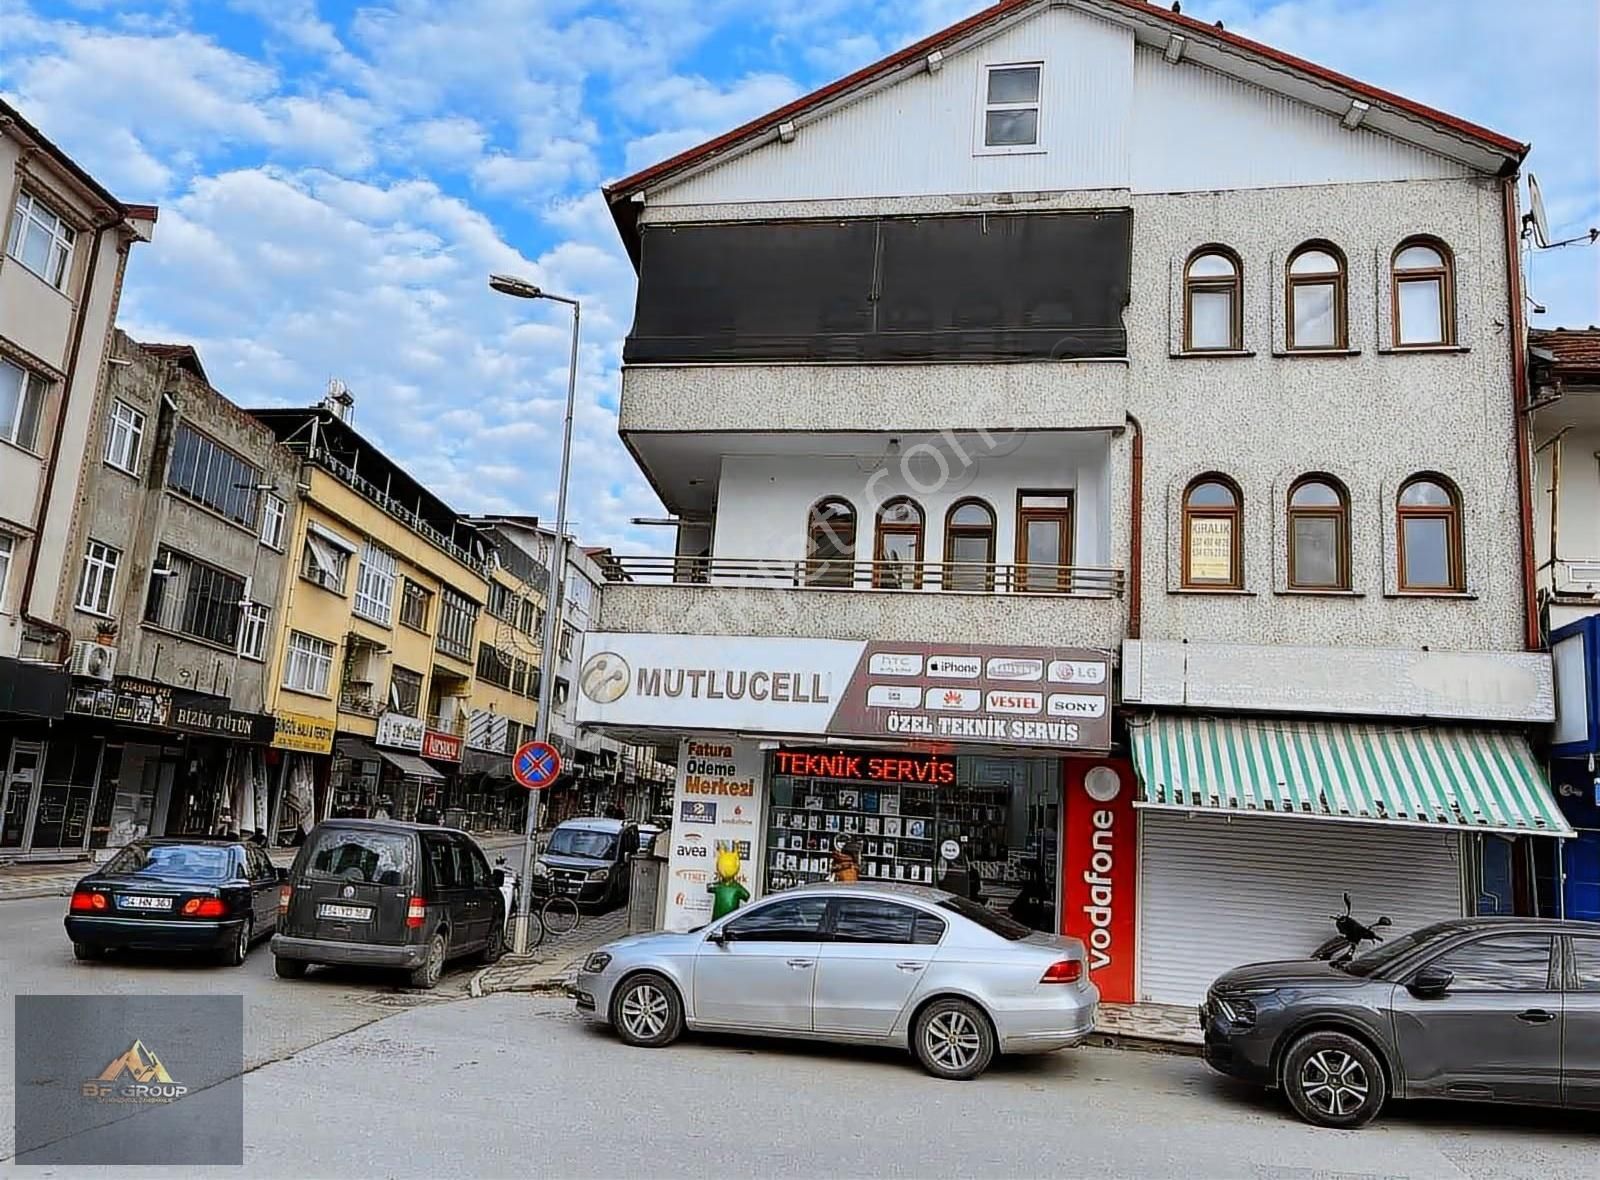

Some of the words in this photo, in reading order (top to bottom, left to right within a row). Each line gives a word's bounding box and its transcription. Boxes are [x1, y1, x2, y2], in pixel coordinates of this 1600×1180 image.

[940, 661, 978, 674] iPhone
[1077, 667, 1098, 679] LG
[636, 667, 829, 704] MUTLUCELL
[990, 695, 1040, 710] VESTEL
[1054, 700, 1098, 713] SONY
[887, 711, 934, 735] ÖZEL
[938, 715, 1008, 739] TEKNİK
[1009, 719, 1080, 743] SERVİS
[687, 741, 733, 758] Fatura
[686, 756, 737, 777] Ödeme
[776, 750, 863, 779] TEKNİK
[868, 756, 955, 784] SERVİS
[684, 775, 755, 797] Merkezi
[676, 845, 707, 857] avea
[1083, 809, 1115, 970] vodafone
